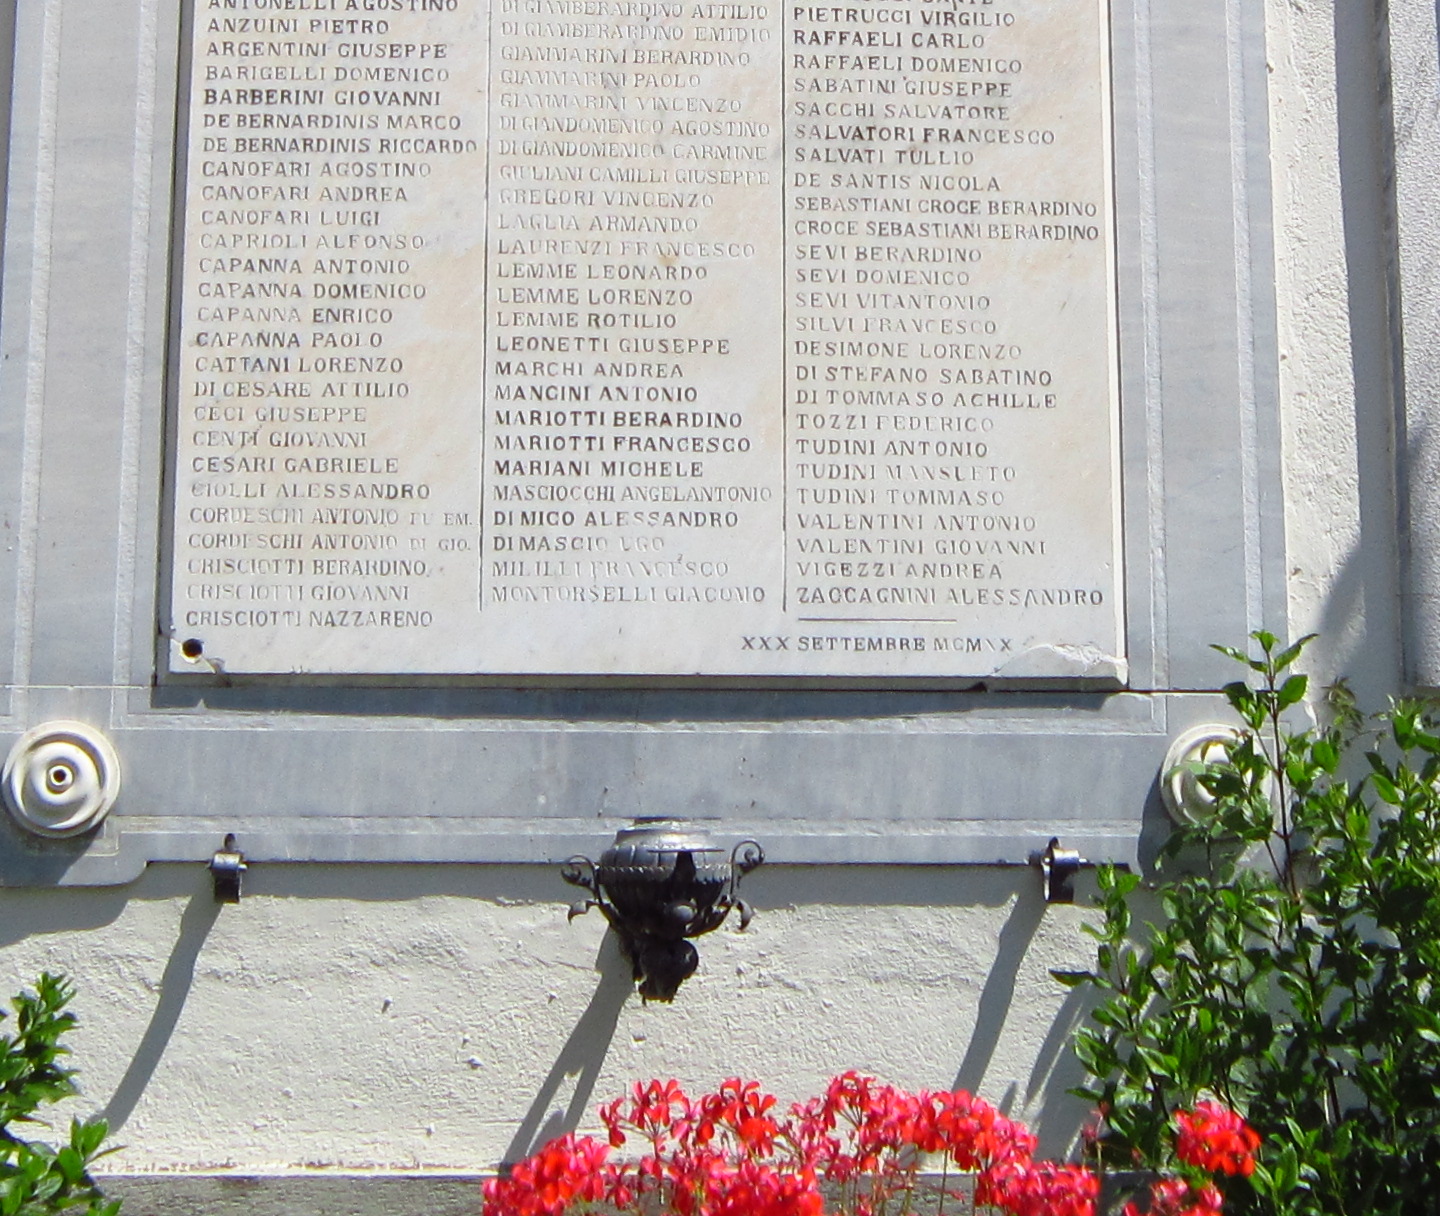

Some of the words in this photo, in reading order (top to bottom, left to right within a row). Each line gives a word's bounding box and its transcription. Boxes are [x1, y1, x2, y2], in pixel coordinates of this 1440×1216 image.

[794, 30, 901, 46] RAFFAELI
[912, 33, 984, 48] CARLO
[794, 54, 902, 70] RAFFAELI
[912, 57, 1021, 73] DOMENICO
[795, 148, 884, 163] SALVATI
[895, 150, 973, 165] TULLIO
[496, 289, 579, 304] LEMME
[588, 289, 692, 305] LORENZO
[796, 366, 816, 381] DI
[825, 367, 927, 383] STEFANO
[940, 369, 1052, 386] SABATINO
[496, 411, 604, 426] MARIOTTI
[613, 411, 742, 428] BERARDINO
[495, 436, 604, 450] MARIOTTI
[613, 436, 751, 452] FRANCESCO
[796, 439, 875, 455] TUDINI
[885, 441, 987, 457] ANTONIO
[192, 457, 274, 472] CESARI
[285, 458, 398, 473] GABRIELE
[742, 636, 790, 650] XXX
[798, 637, 926, 651] SETTEMBRE
